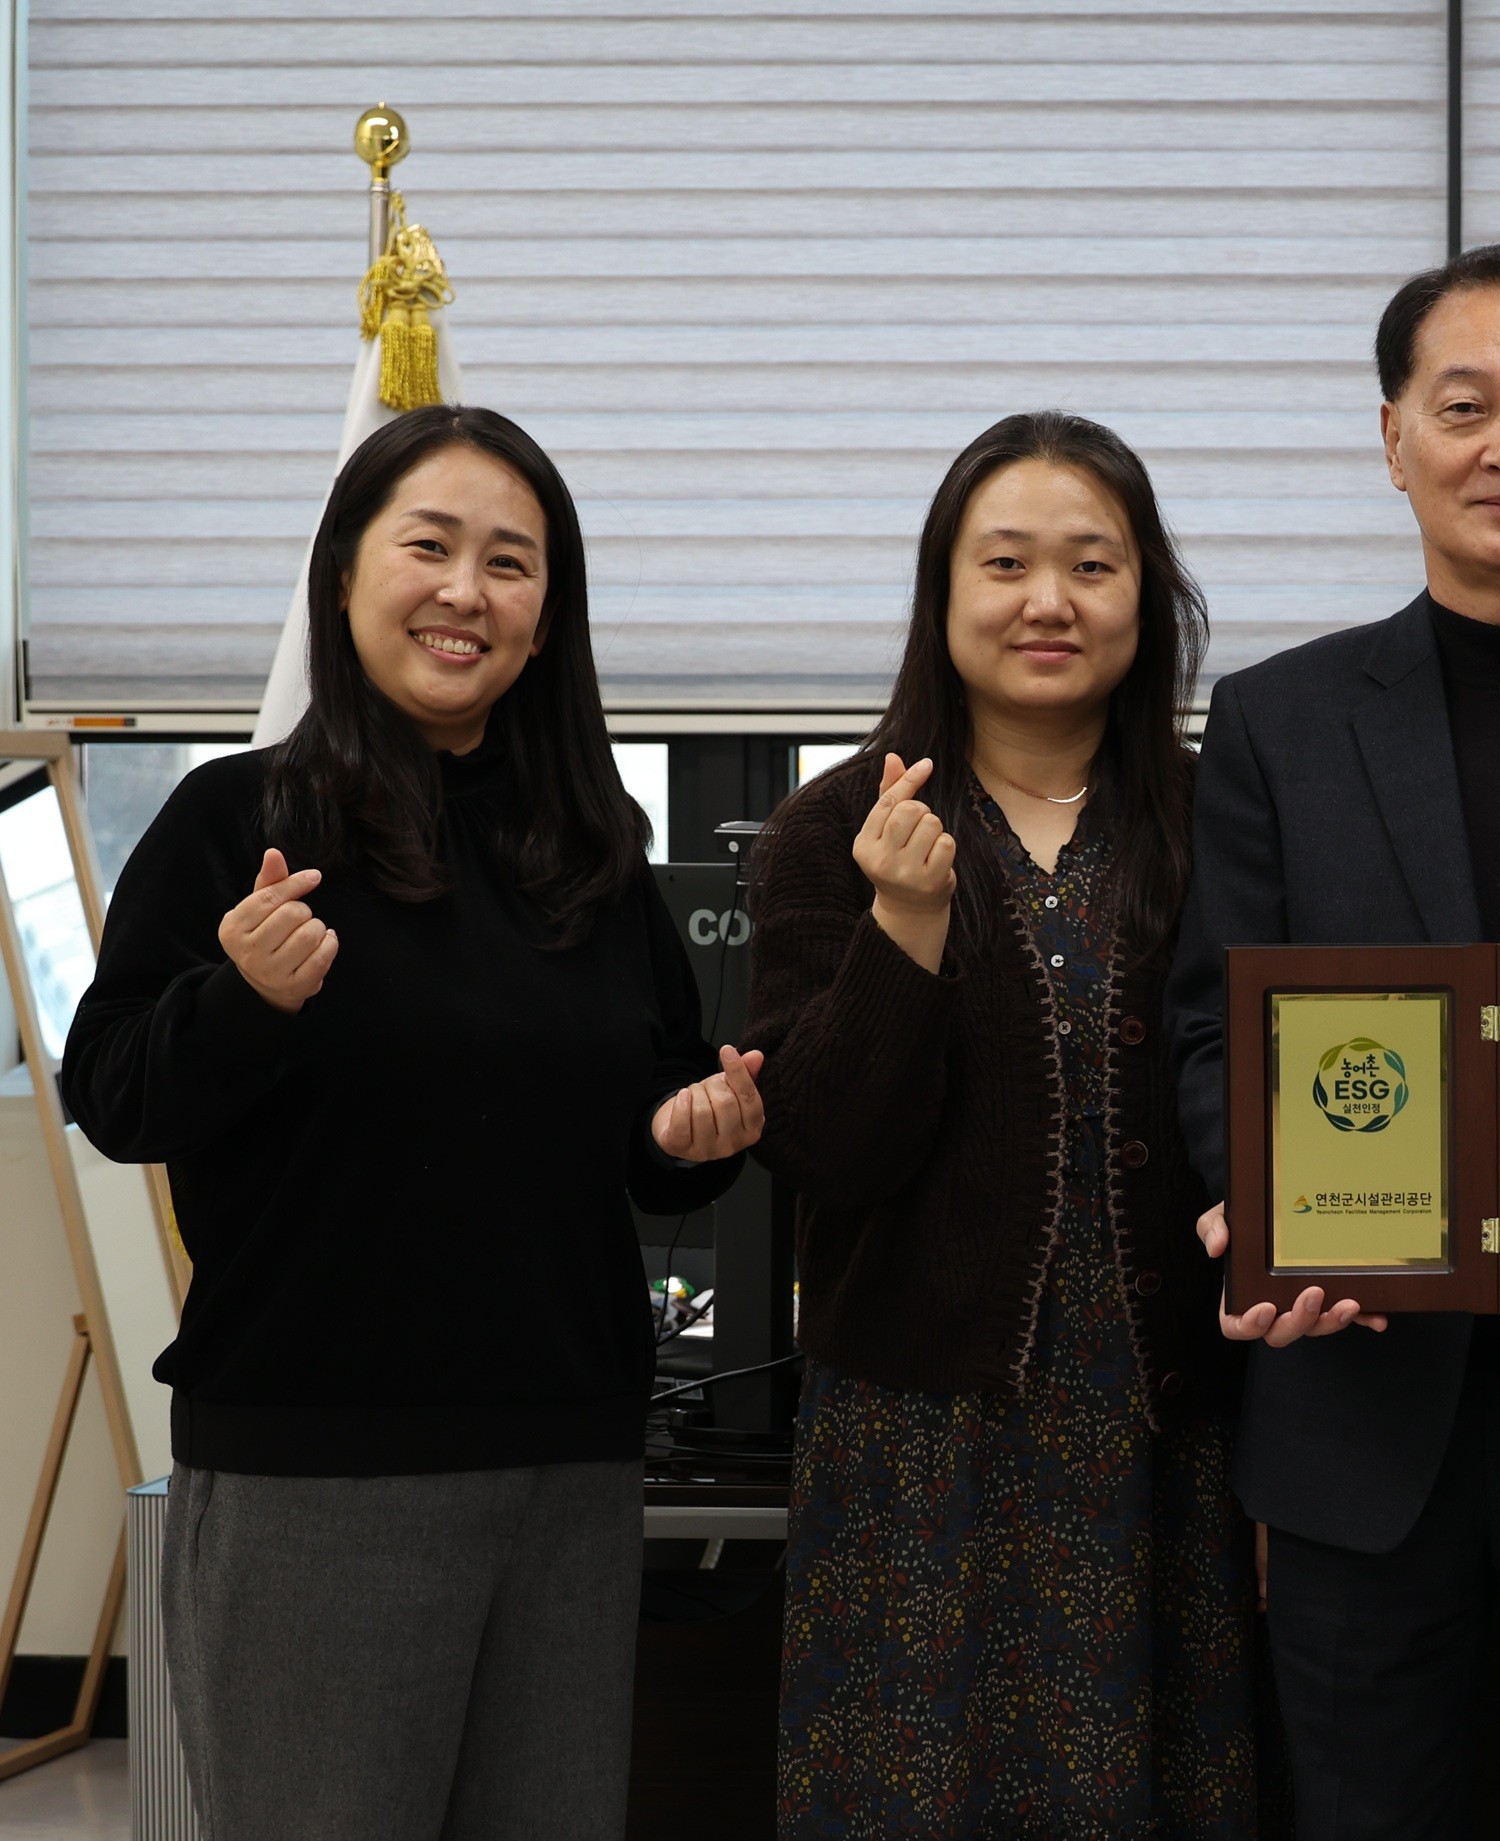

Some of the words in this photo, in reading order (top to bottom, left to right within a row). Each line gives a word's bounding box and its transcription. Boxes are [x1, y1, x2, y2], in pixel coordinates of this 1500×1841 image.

[688, 908, 756, 946] CO
[1341, 1054, 1380, 1078] 농어촌
[1335, 1080, 1390, 1100] ESG
[1343, 1103, 1381, 1114] 실천인정
[1315, 1192, 1432, 1207] 연천군시설관리공단
